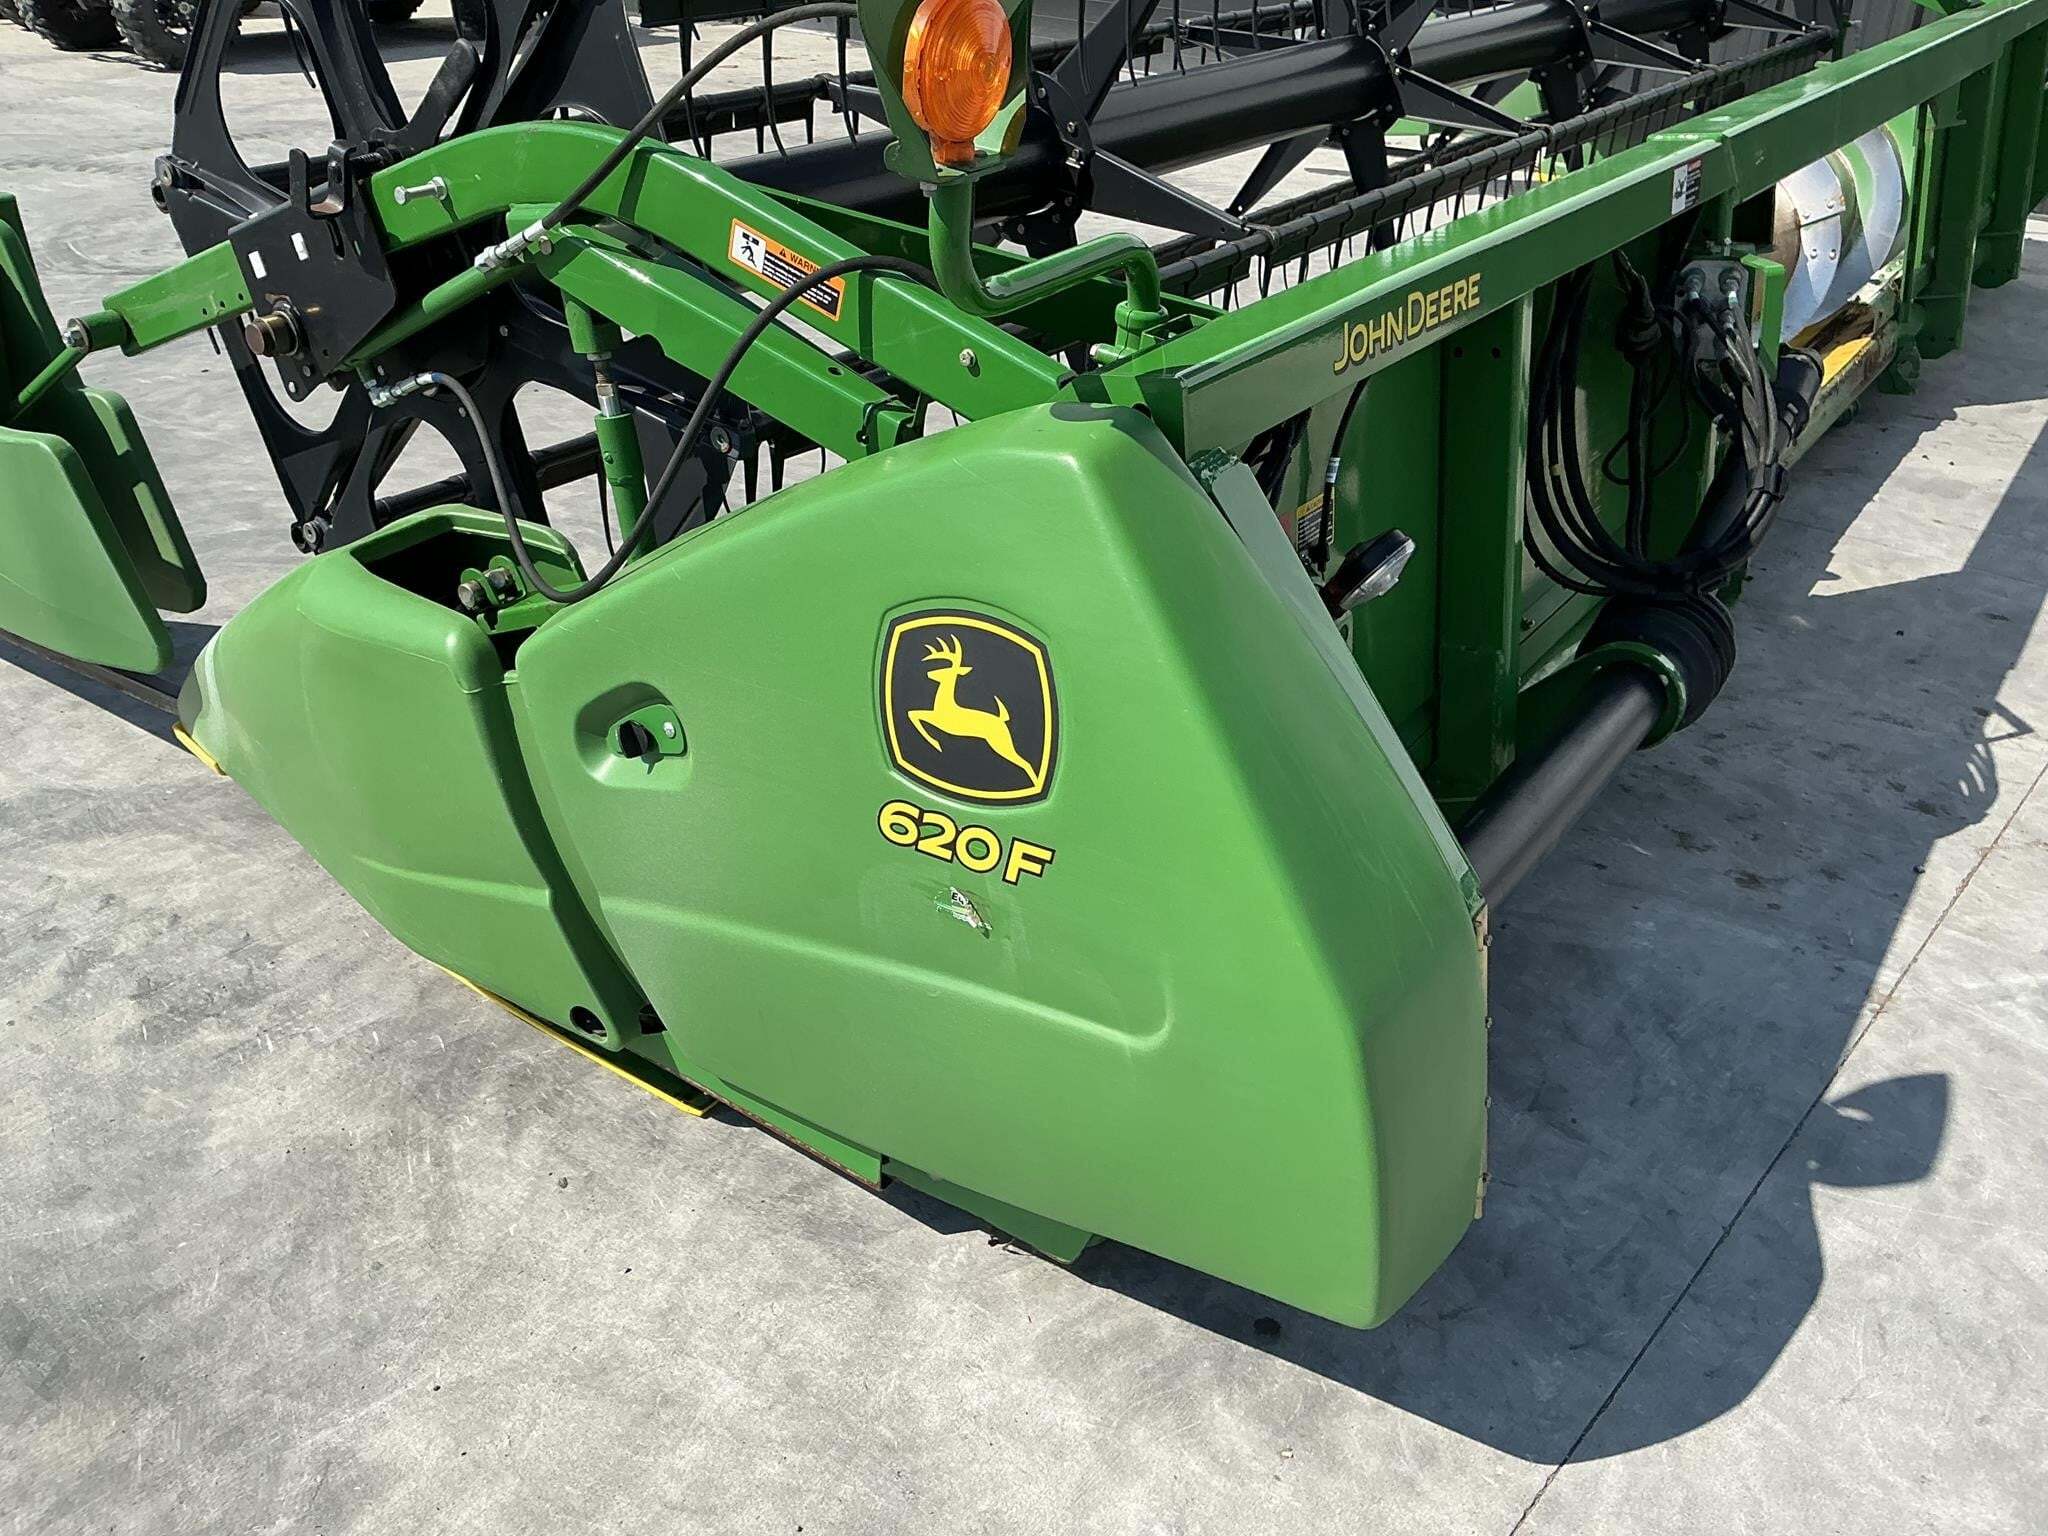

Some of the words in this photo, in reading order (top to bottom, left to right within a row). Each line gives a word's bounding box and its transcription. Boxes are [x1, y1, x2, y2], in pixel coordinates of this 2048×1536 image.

[790, 253, 821, 273] WARN
[1333, 306, 1403, 375] JOHN
[1407, 273, 1481, 340] DEERE
